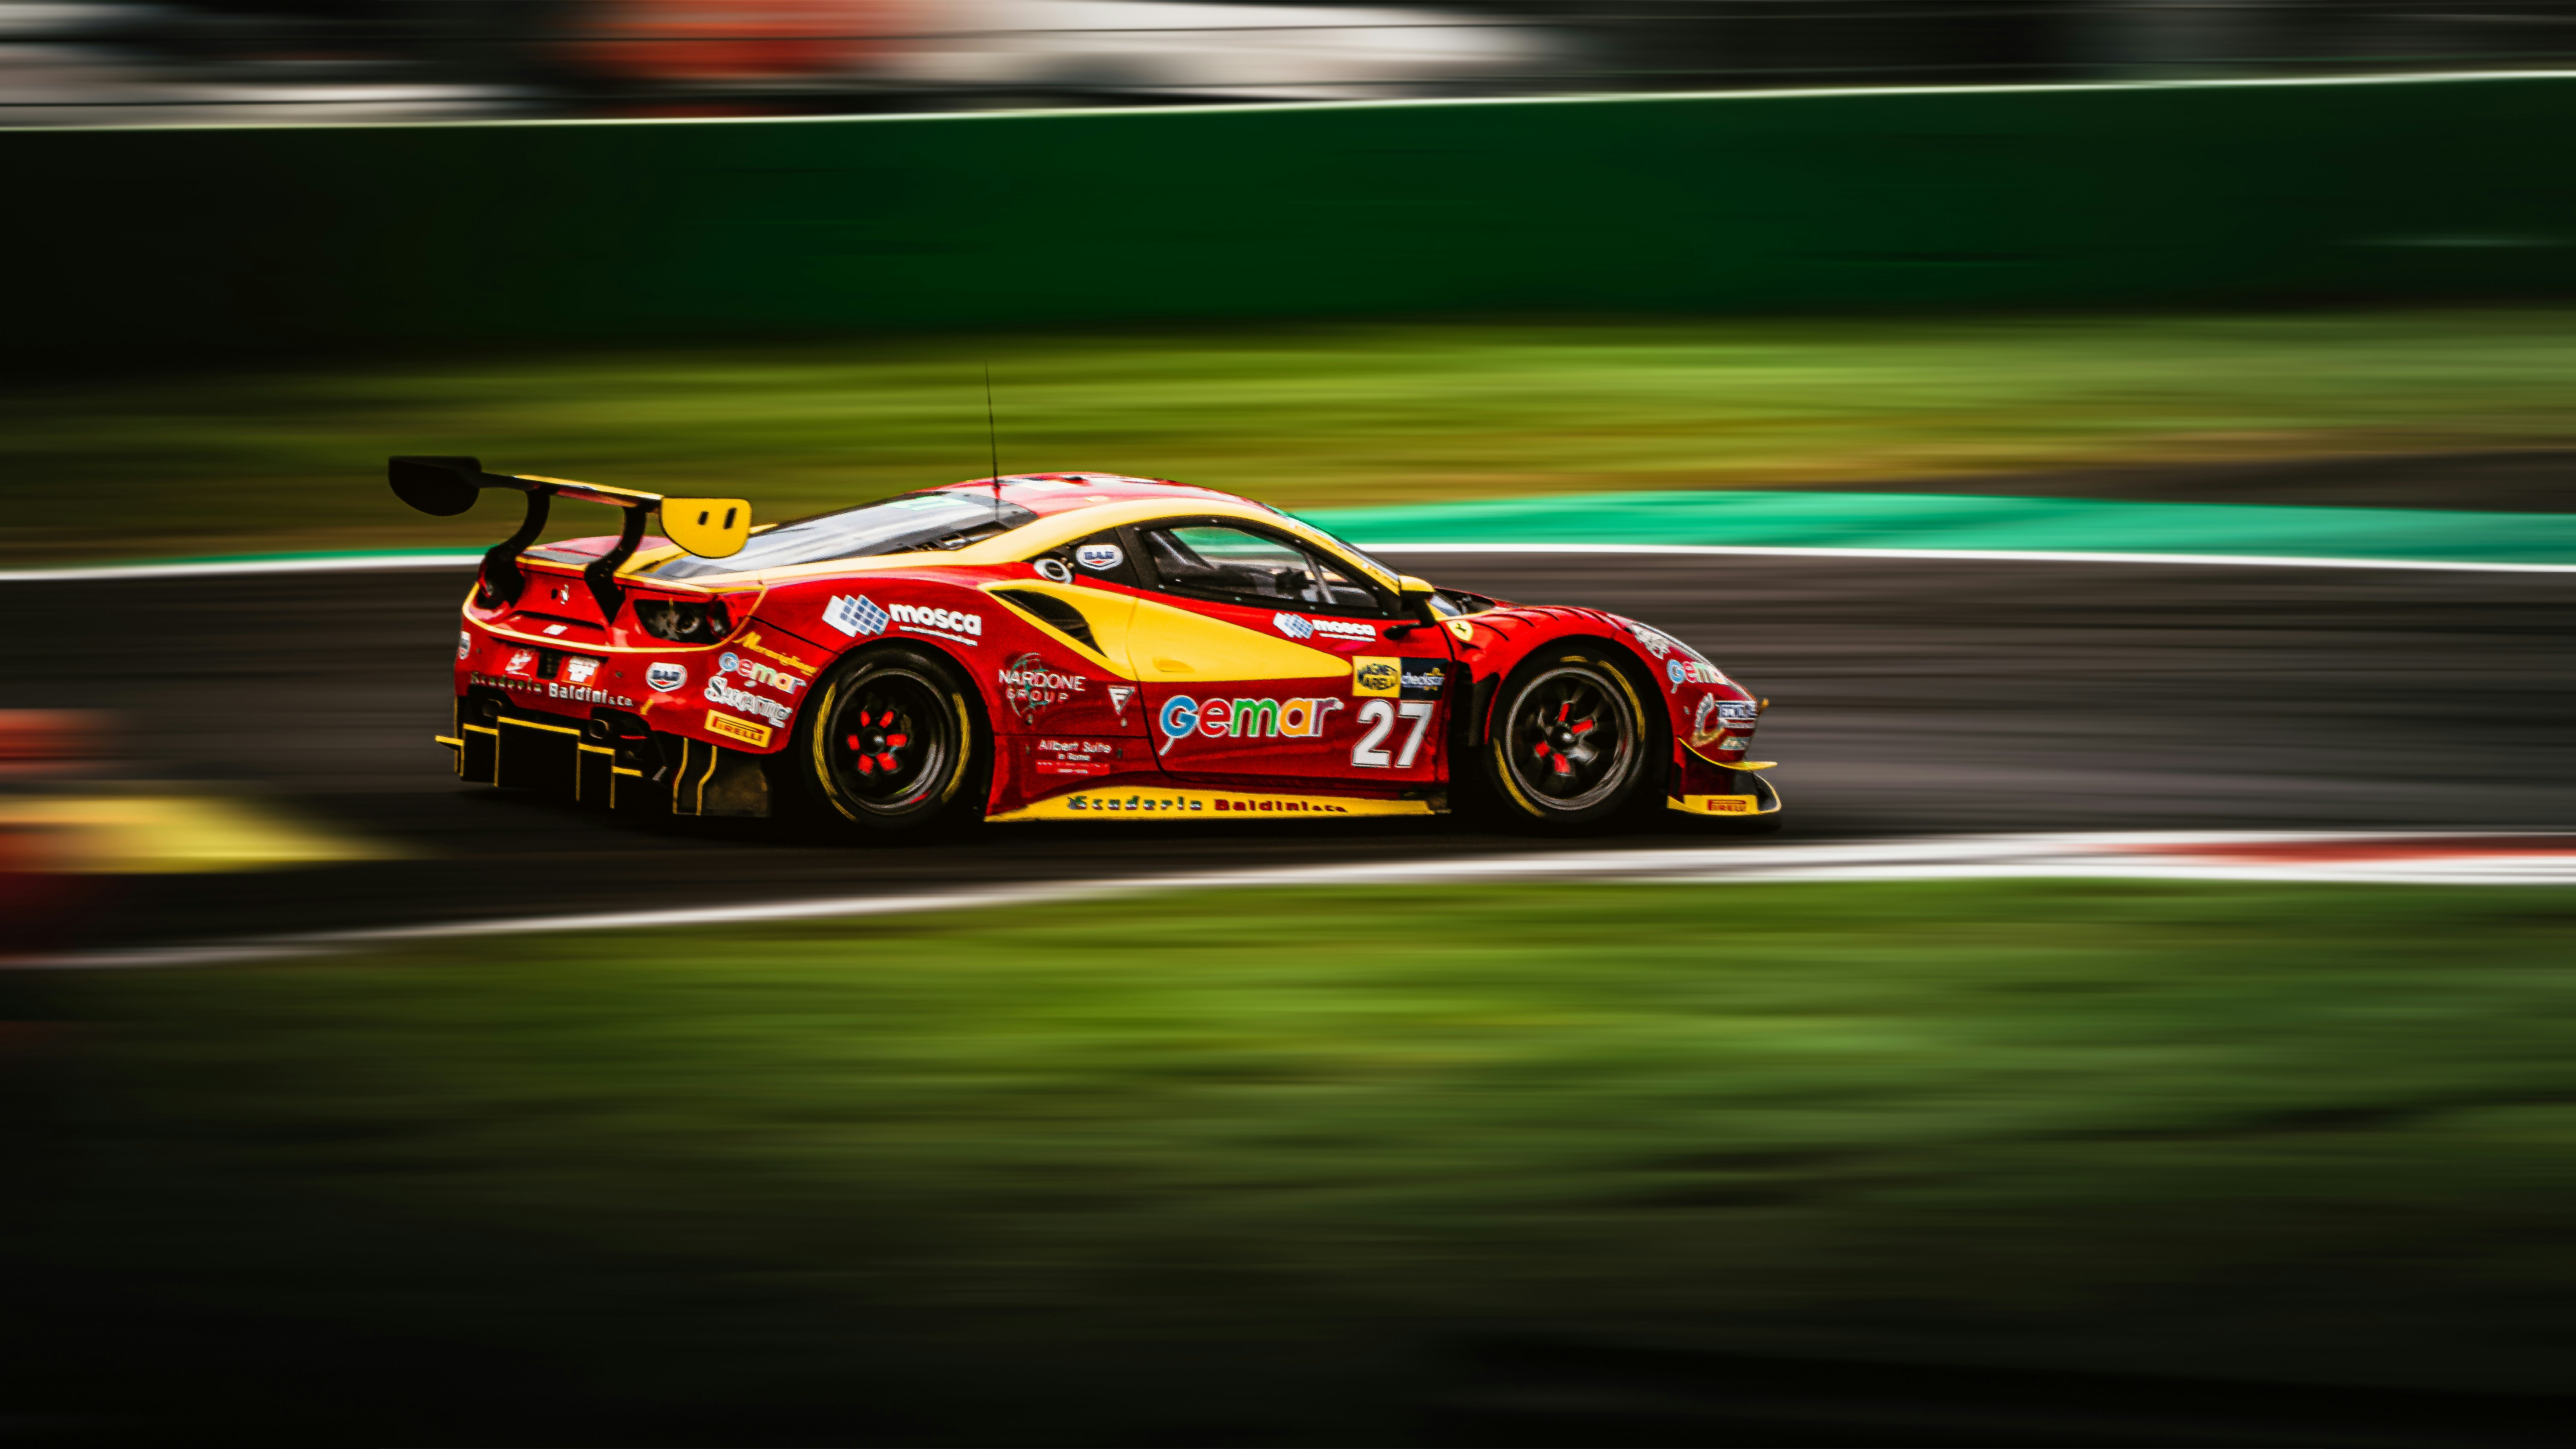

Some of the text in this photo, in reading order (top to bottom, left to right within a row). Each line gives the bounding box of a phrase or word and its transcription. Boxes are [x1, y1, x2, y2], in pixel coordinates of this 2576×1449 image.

[889, 603, 982, 636] mosca
[1312, 619, 1376, 636] mosca
[471, 671, 542, 694] Scuderia
[549, 682, 608, 704] Baldini
[719, 652, 807, 694] Gemar
[999, 669, 1086, 691] NARDONE
[1006, 687, 1068, 703] GROUP
[1159, 696, 1344, 756] Gemar
[1351, 700, 1435, 768] 27
[1067, 796, 1203, 810] Scuderia
[1215, 799, 1308, 812] Baldini
